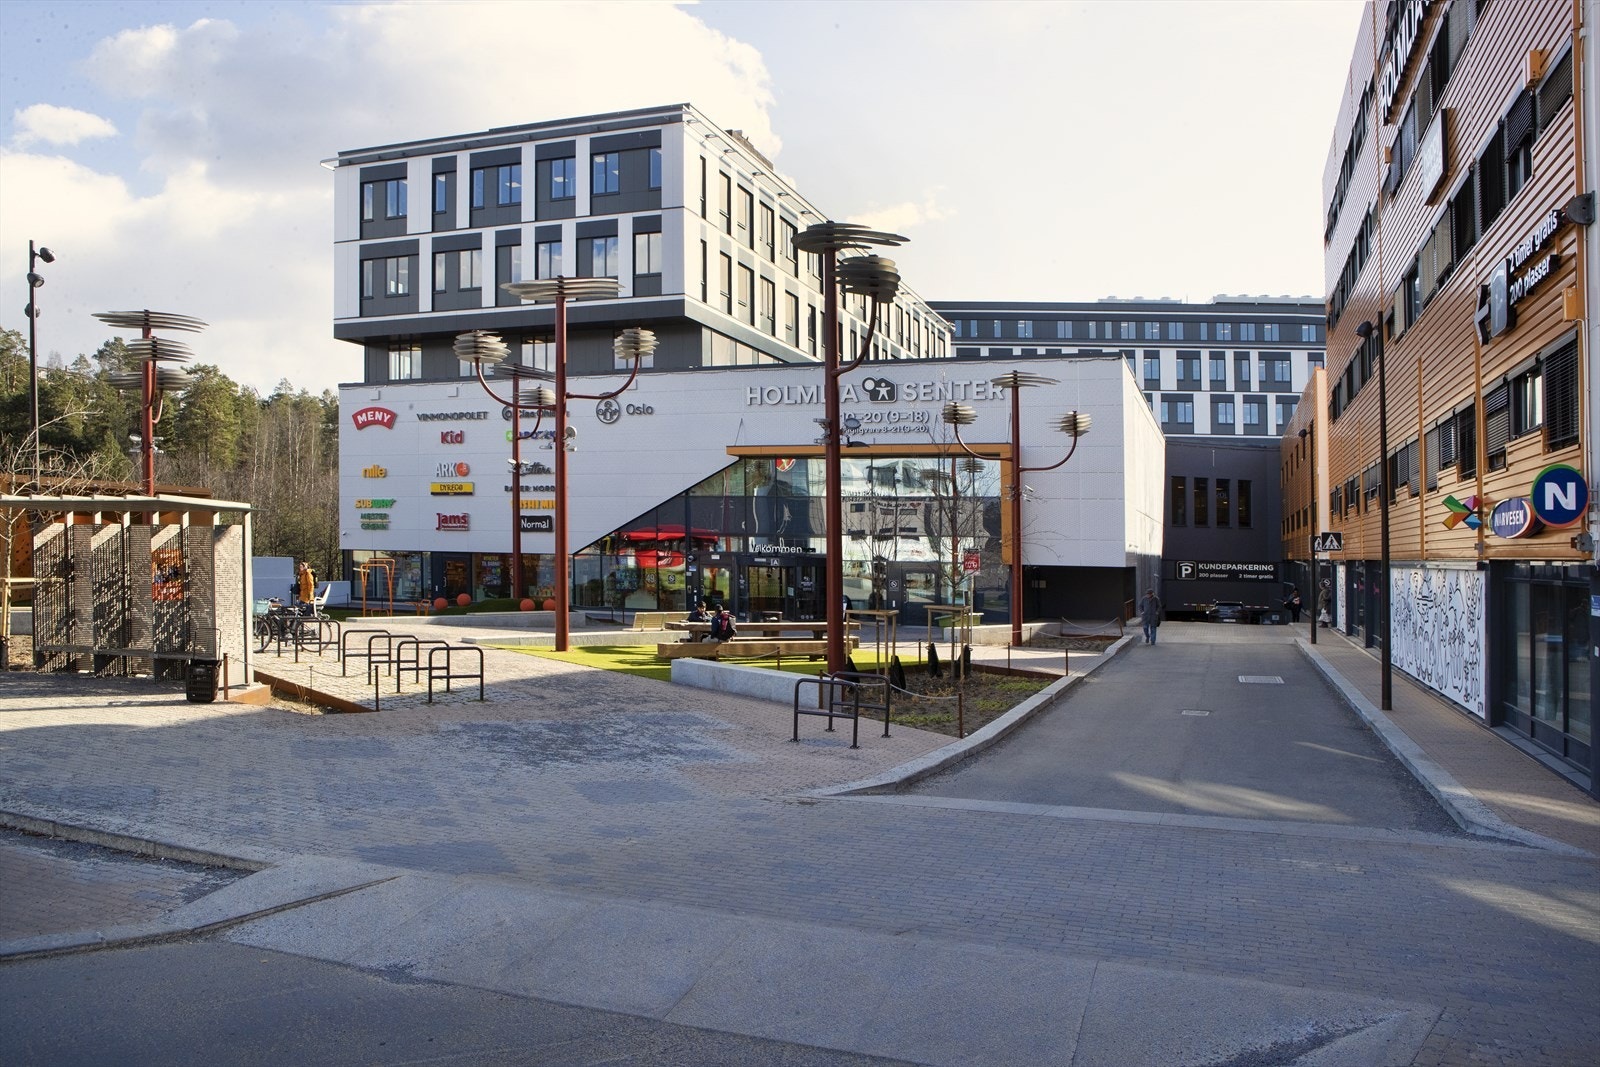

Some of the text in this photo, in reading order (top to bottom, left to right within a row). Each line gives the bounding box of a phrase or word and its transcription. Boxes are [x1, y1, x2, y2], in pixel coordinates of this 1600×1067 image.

[1509, 211, 1558, 274] 2 timer gratis
[1509, 256, 1551, 306] 200 plasser
[746, 380, 1005, 406] HOLMA SENTER
[416, 411, 488, 421] VINMONOPOLET
[625, 403, 654, 416] Oslo
[356, 410, 392, 425] MENY
[440, 431, 464, 444] Kid
[362, 464, 386, 478] nille
[436, 463, 457, 477] ARK
[504, 485, 529, 493] BAER
[355, 499, 397, 508] SUBWAY
[1545, 482, 1577, 511] N
[435, 512, 468, 531] Jams
[521, 518, 549, 529] Normal
[1494, 509, 1524, 528] NARVESEN
[1198, 563, 1274, 571] KUNDEPARKERING
